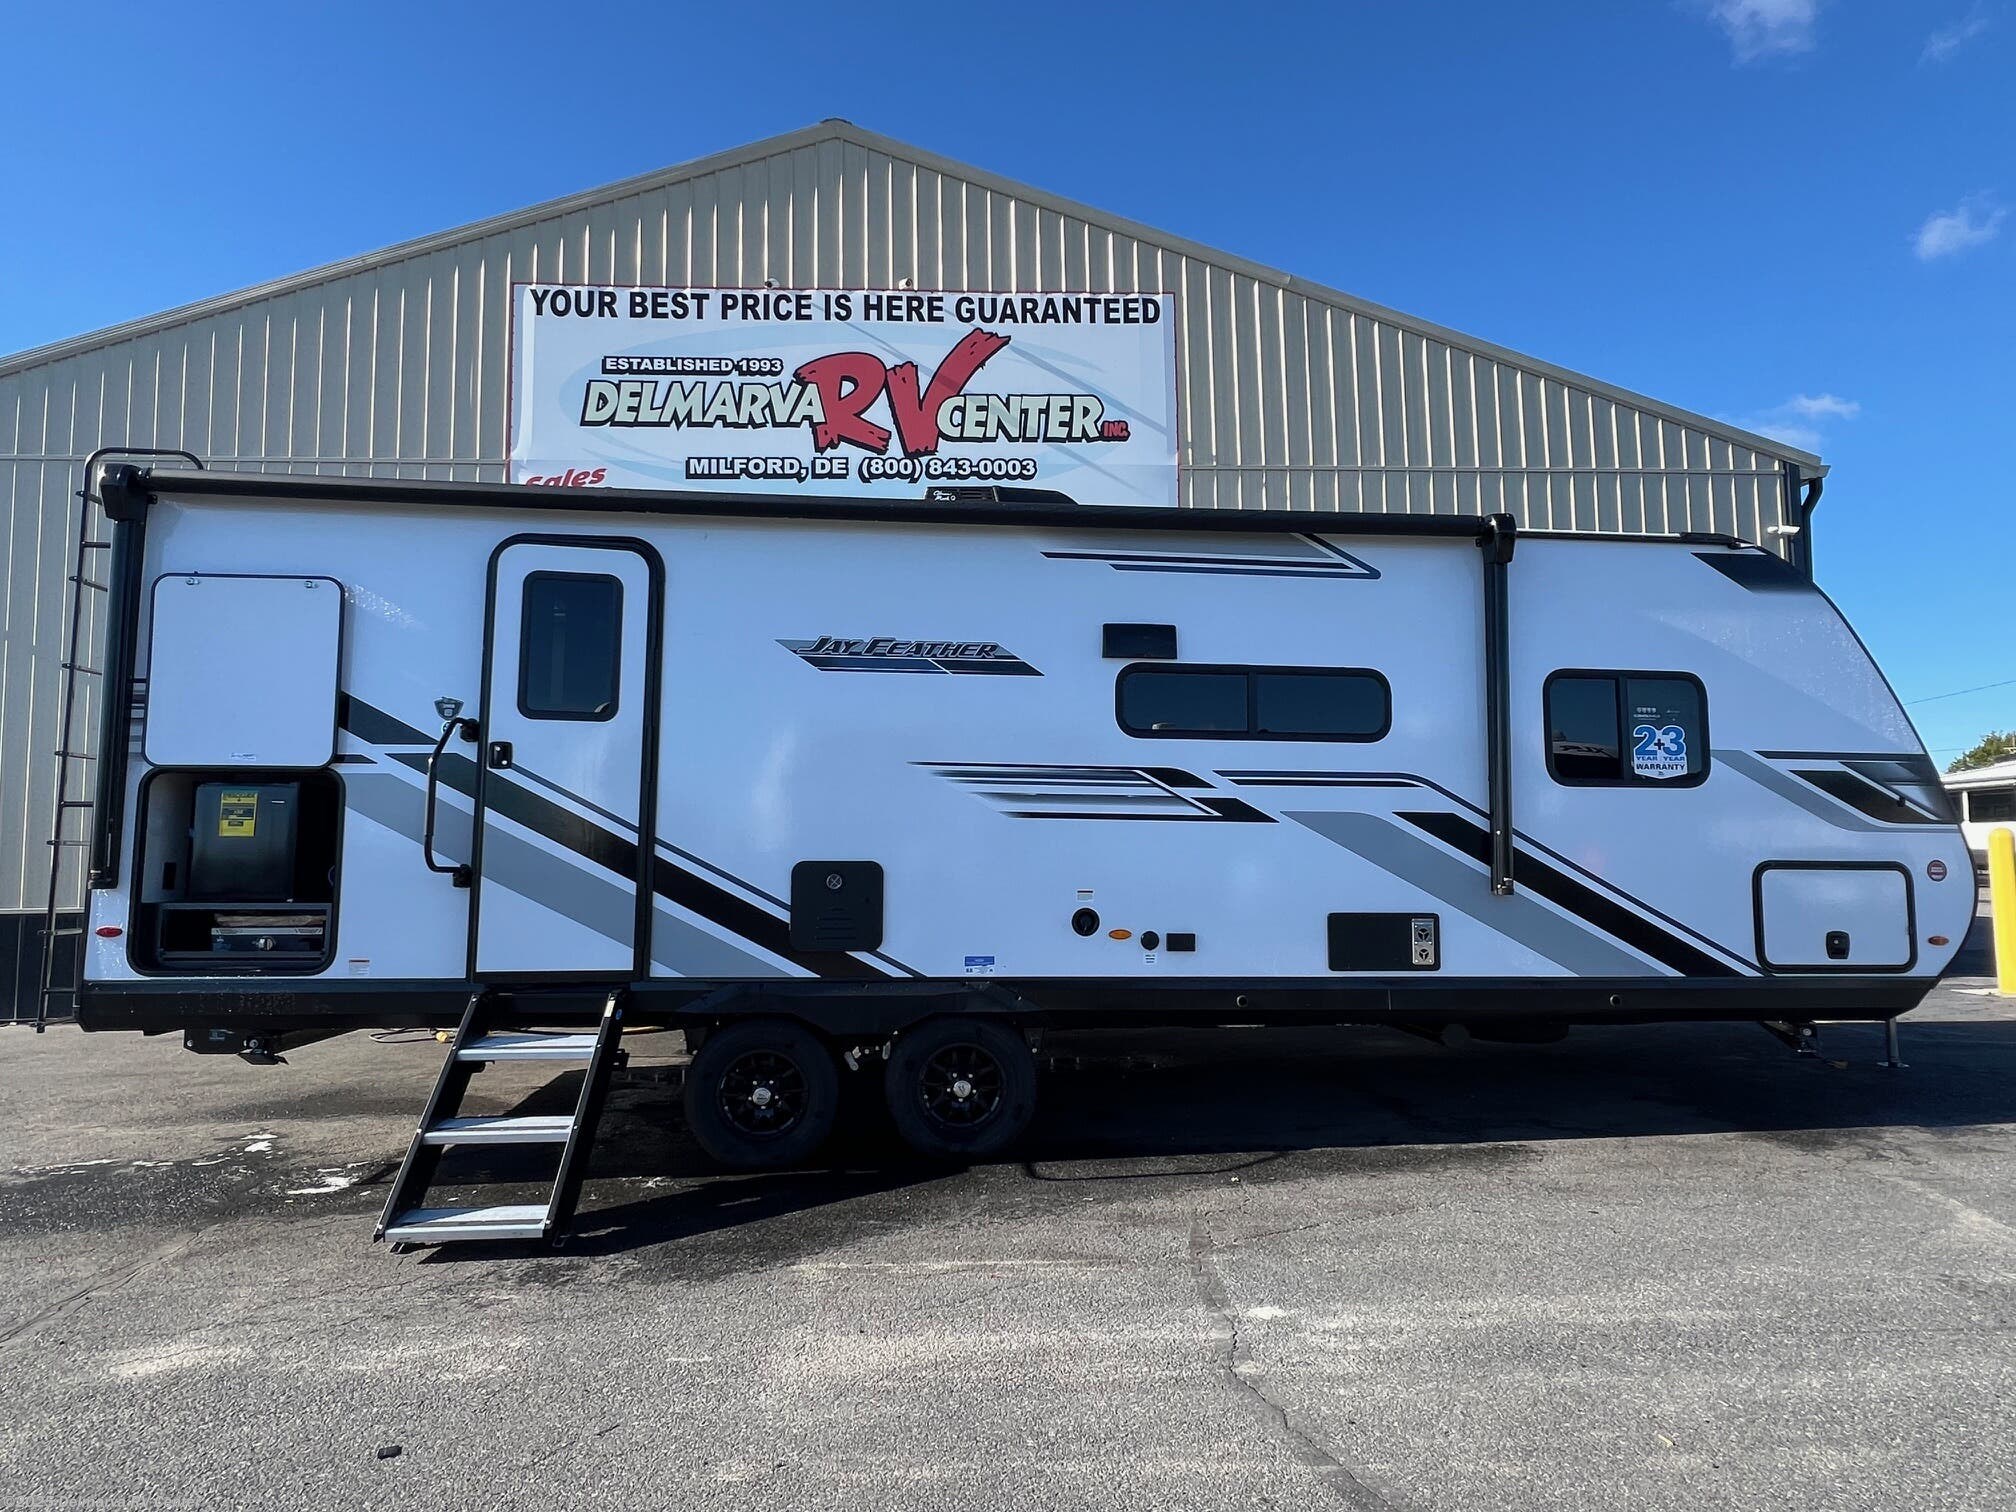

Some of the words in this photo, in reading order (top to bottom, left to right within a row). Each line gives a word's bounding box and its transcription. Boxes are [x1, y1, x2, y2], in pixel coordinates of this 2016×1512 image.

[531, 289, 618, 318] YOUR
[629, 292, 709, 320] BEST
[721, 293, 812, 320] PRICE
[824, 294, 851, 321] IS
[864, 294, 945, 322] HERE
[955, 296, 1160, 324] GUARANTEED
[604, 356, 735, 375] ESTABLISHED
[737, 358, 783, 377] 1993
[581, 380, 828, 430] DELMARVA
[794, 327, 1012, 457] RV
[935, 393, 1105, 442] CENTER
[1101, 420, 1131, 440] INC.
[686, 457, 809, 483] MILFORD,
[812, 457, 850, 480] DE
[858, 457, 923, 483] (800)
[925, 457, 1038, 481] 843-0003
[796, 635, 862, 656] JAY
[862, 636, 1001, 659] FEATHER
[1636, 763, 1685, 771] WARRANTY
